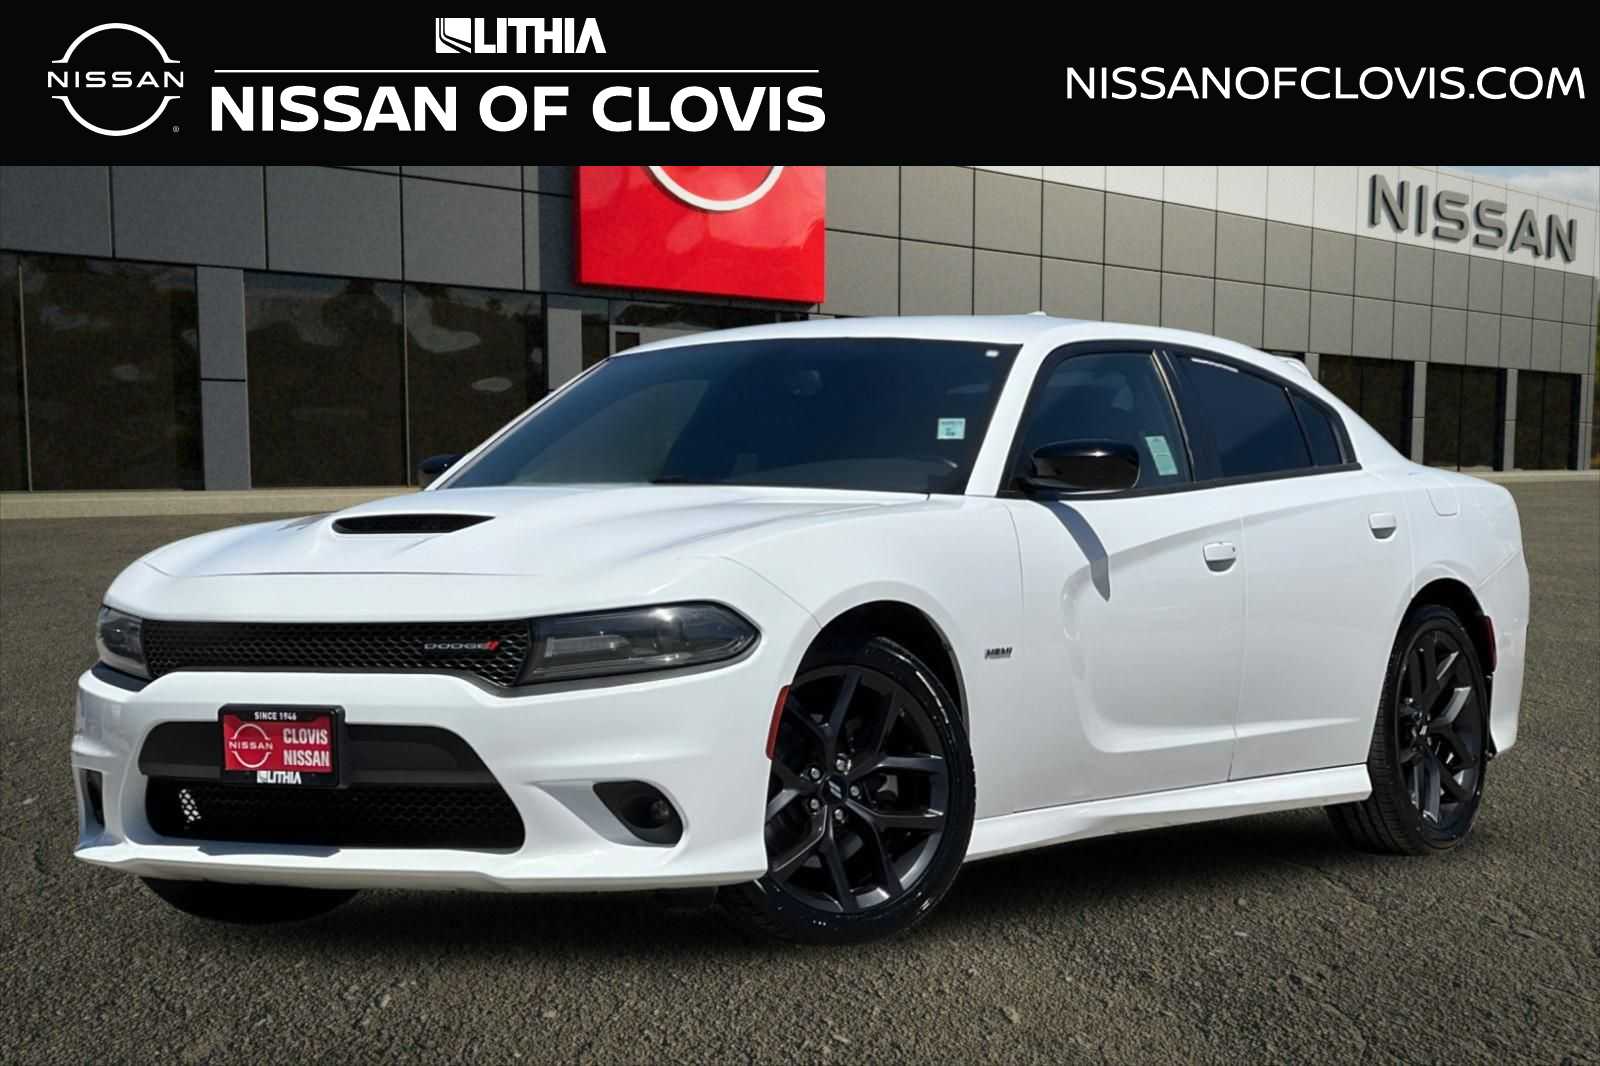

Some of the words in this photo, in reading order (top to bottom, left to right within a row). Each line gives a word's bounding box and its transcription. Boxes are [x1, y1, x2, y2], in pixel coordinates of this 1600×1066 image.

[1368, 174, 1577, 263] NISSAN
[424, 642, 488, 650] DODGE
[254, 711, 278, 720] SINCE
[280, 712, 297, 720] 1946
[283, 728, 328, 745] CLOVIS
[228, 741, 273, 750] NISSAN
[283, 749, 330, 767] NISSAN
[267, 770, 302, 785] LITHIA
